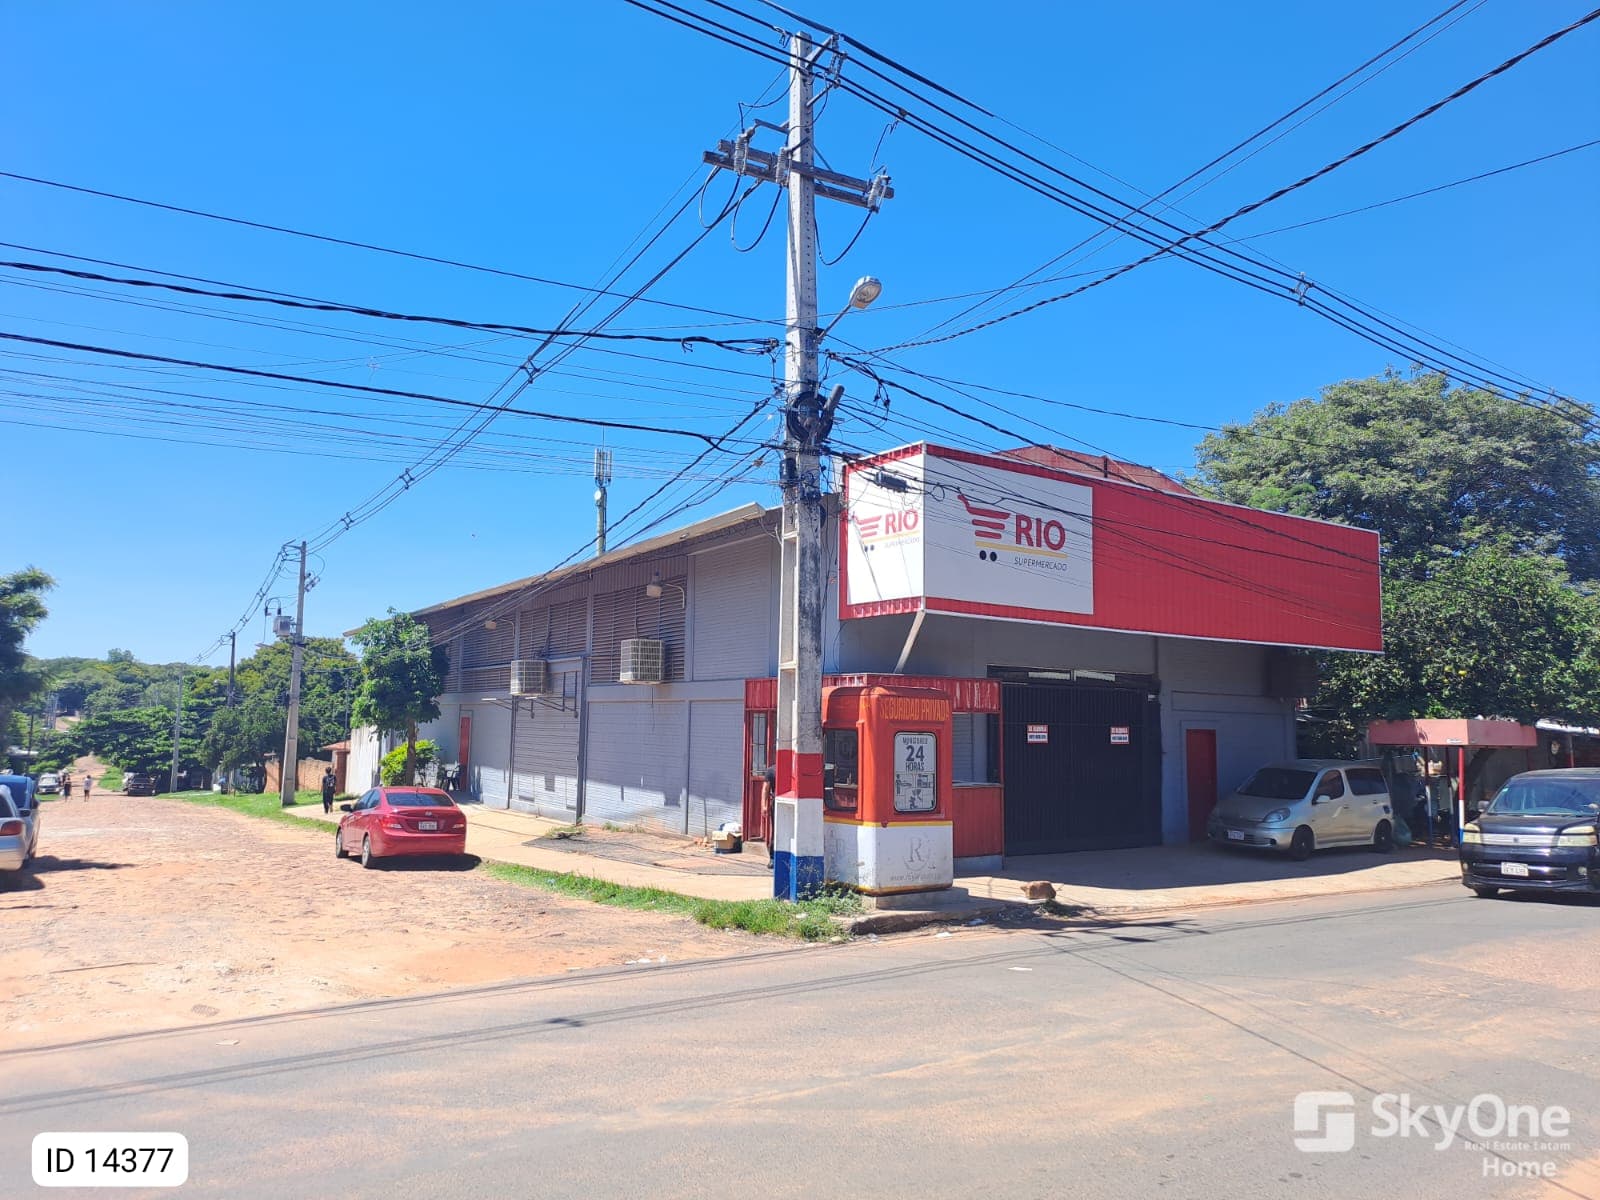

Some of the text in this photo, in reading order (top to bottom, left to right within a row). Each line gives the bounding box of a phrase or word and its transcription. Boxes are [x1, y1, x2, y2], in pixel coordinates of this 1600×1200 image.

[885, 509, 919, 535] RIO
[1015, 513, 1066, 551] RIO
[1014, 557, 1068, 571] SUPERMERCADO
[880, 696, 950, 721] SEGURIDAD PRIVADA
[906, 745, 925, 762] 24
[905, 762, 925, 772] HORAS
